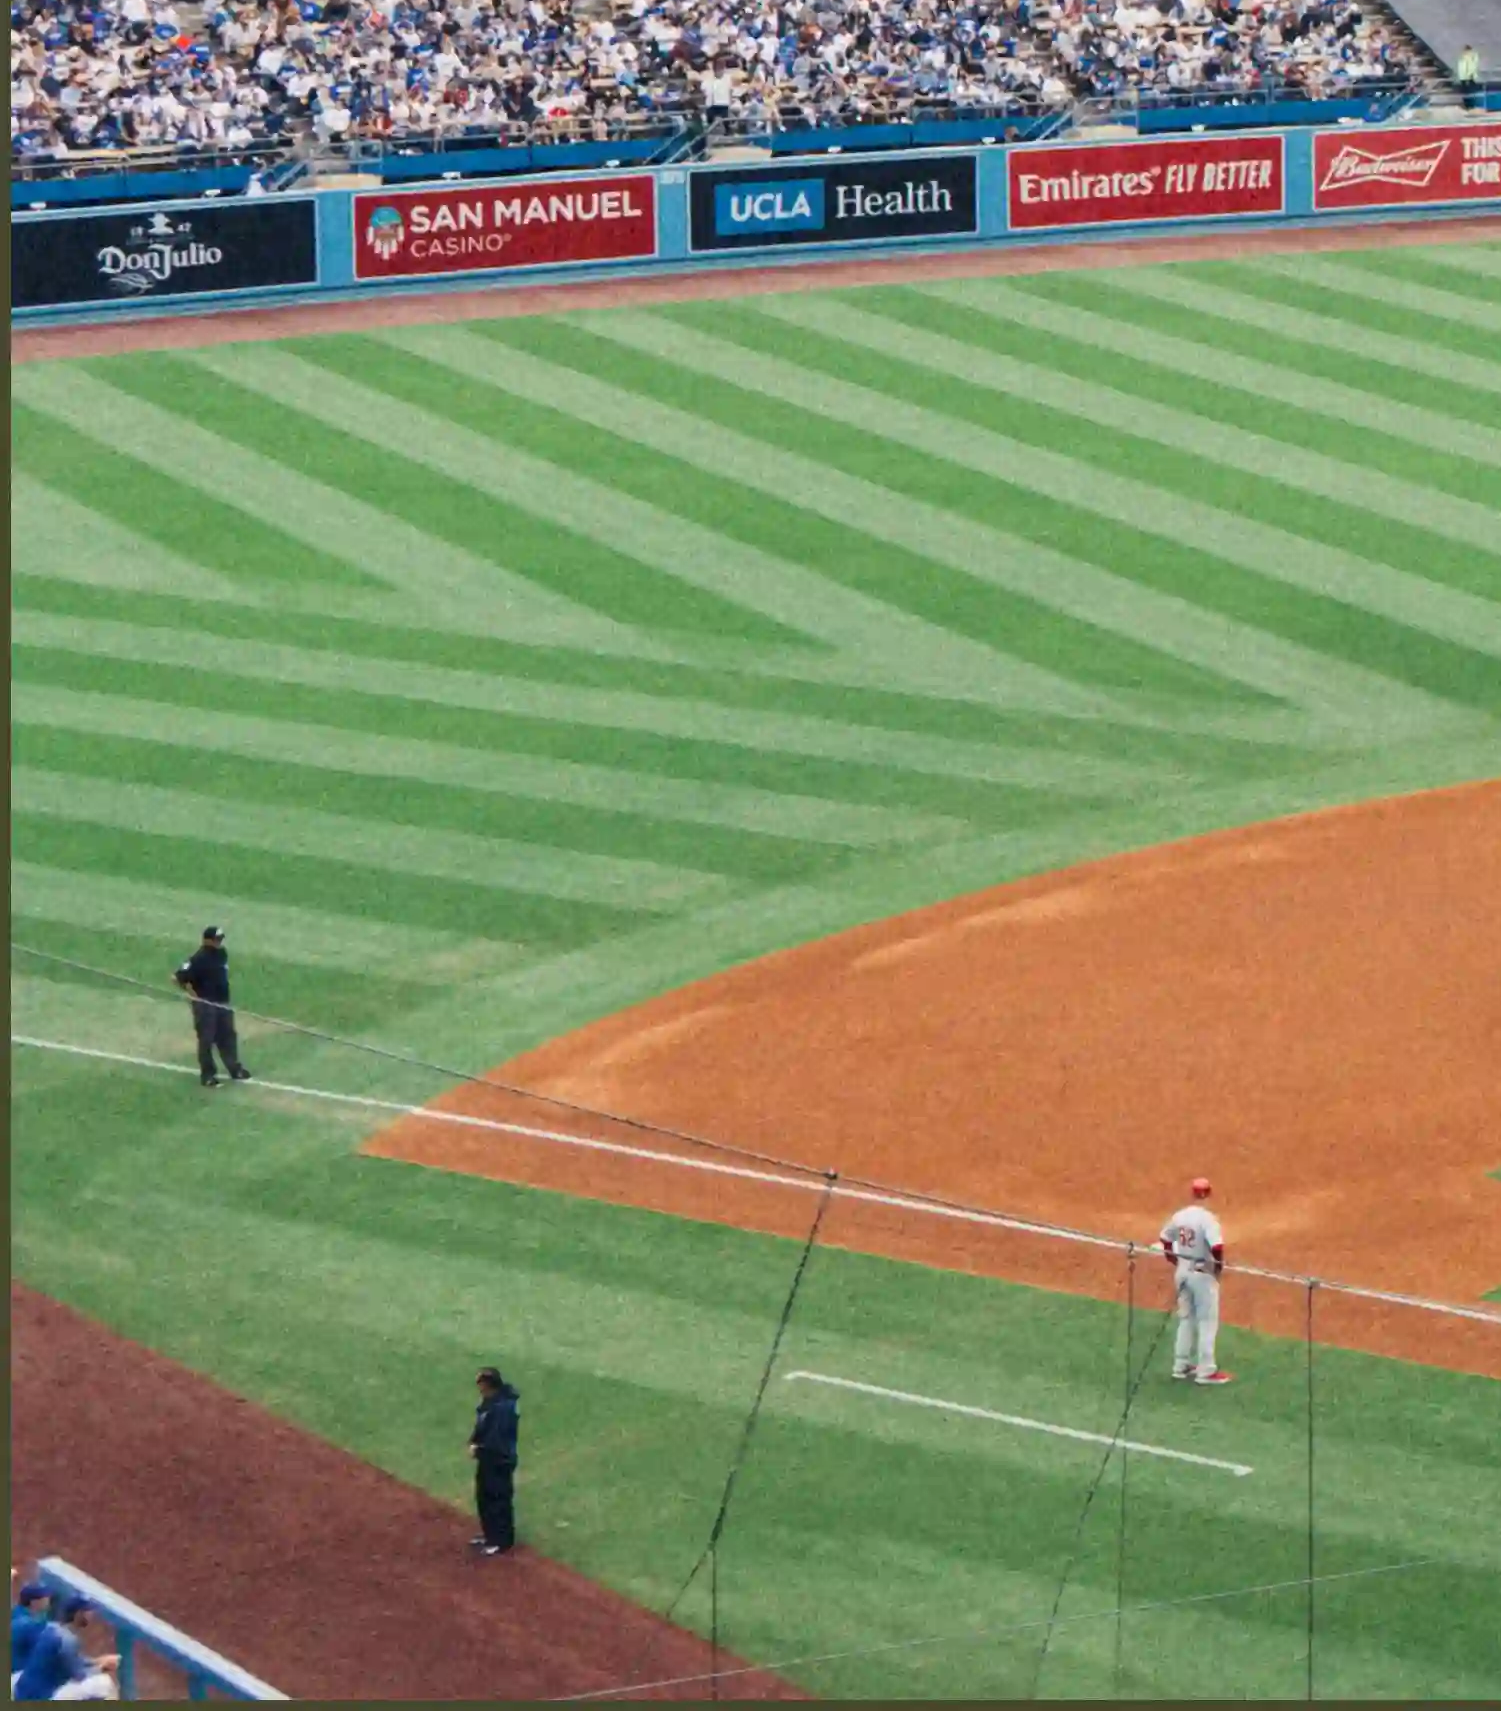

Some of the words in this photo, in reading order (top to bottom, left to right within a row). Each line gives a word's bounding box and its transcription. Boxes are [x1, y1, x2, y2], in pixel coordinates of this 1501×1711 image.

[1019, 169, 1154, 204] Emirates
[1165, 164, 1197, 194] FLY
[1202, 159, 1273, 192] BETTER
[1332, 155, 1437, 178] Budweiser
[1461, 162, 1501, 184] FOR
[410, 202, 483, 233] SAN
[495, 190, 643, 227] MANUEL
[730, 190, 812, 222] UCLA
[835, 181, 952, 219] Health
[97, 245, 161, 274] Don
[148, 242, 223, 280] Julio
[410, 234, 503, 258] CASINO
